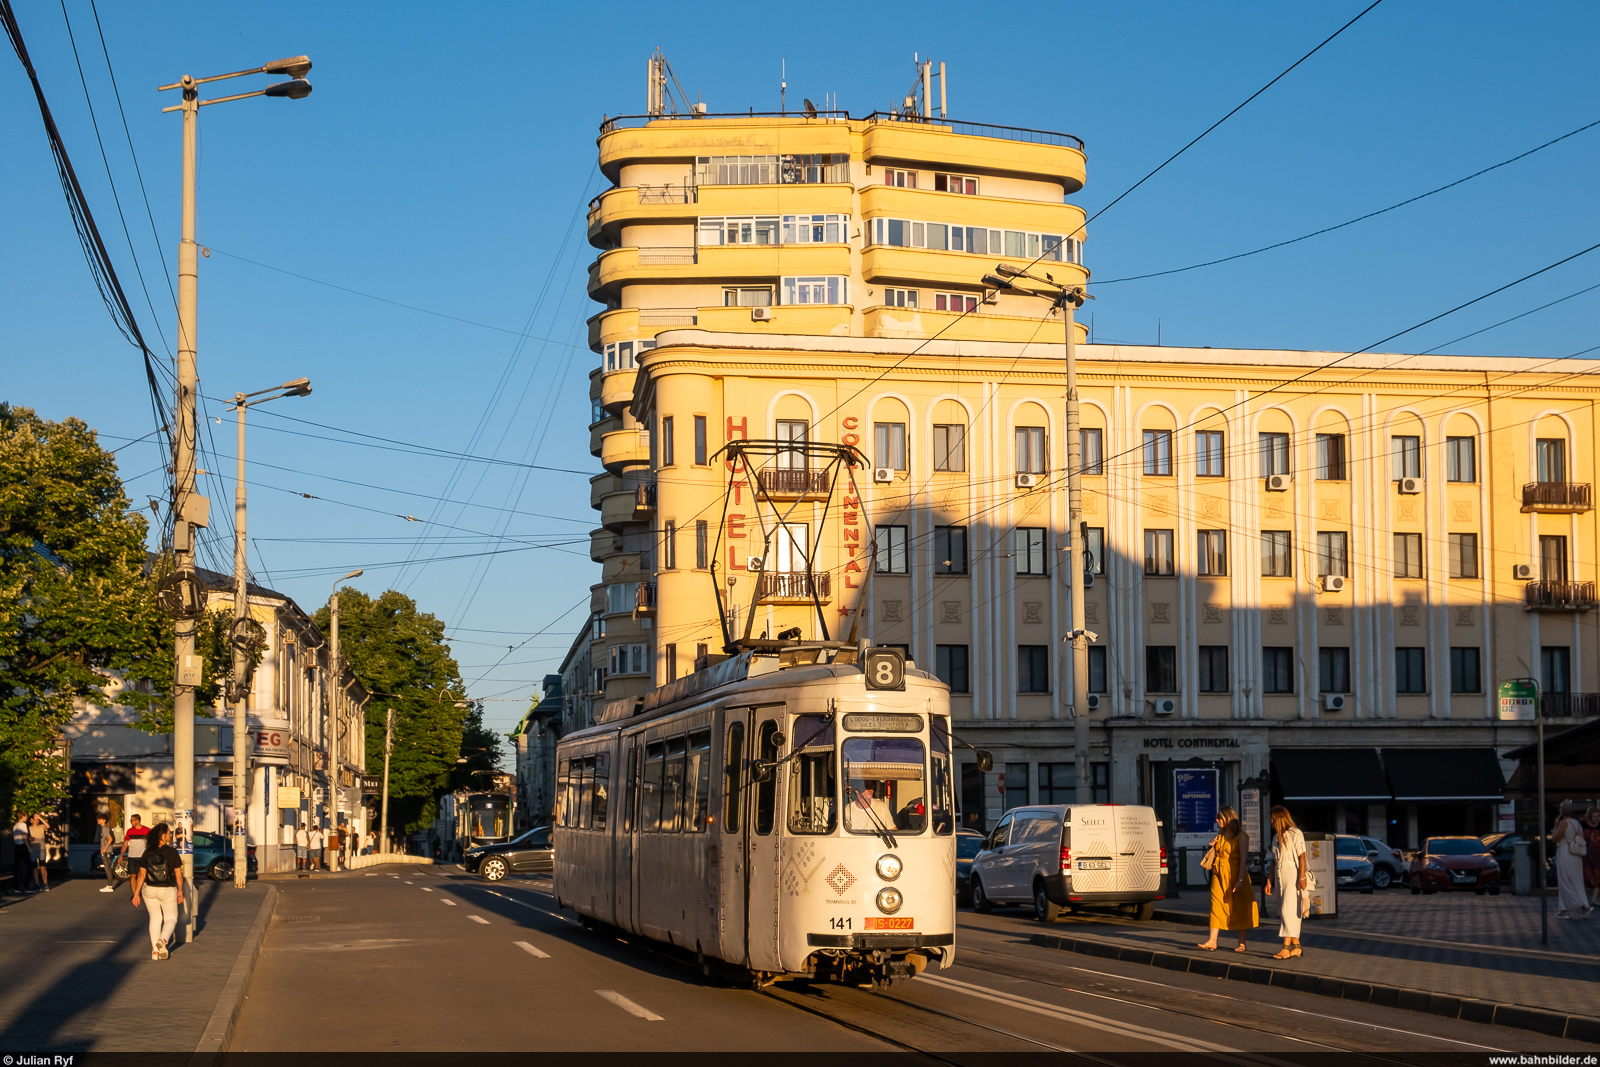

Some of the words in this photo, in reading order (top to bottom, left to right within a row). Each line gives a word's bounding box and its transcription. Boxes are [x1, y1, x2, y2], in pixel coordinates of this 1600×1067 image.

[726, 415, 748, 571] HOTEL
[842, 417, 861, 589] COTINENTAL
[876, 661, 893, 684] 8
[1143, 738, 1174, 748] HOTEL
[1178, 738, 1240, 748] CONTINENTAL
[829, 917, 852, 930] 141
[875, 918, 912, 929] IS-0227
